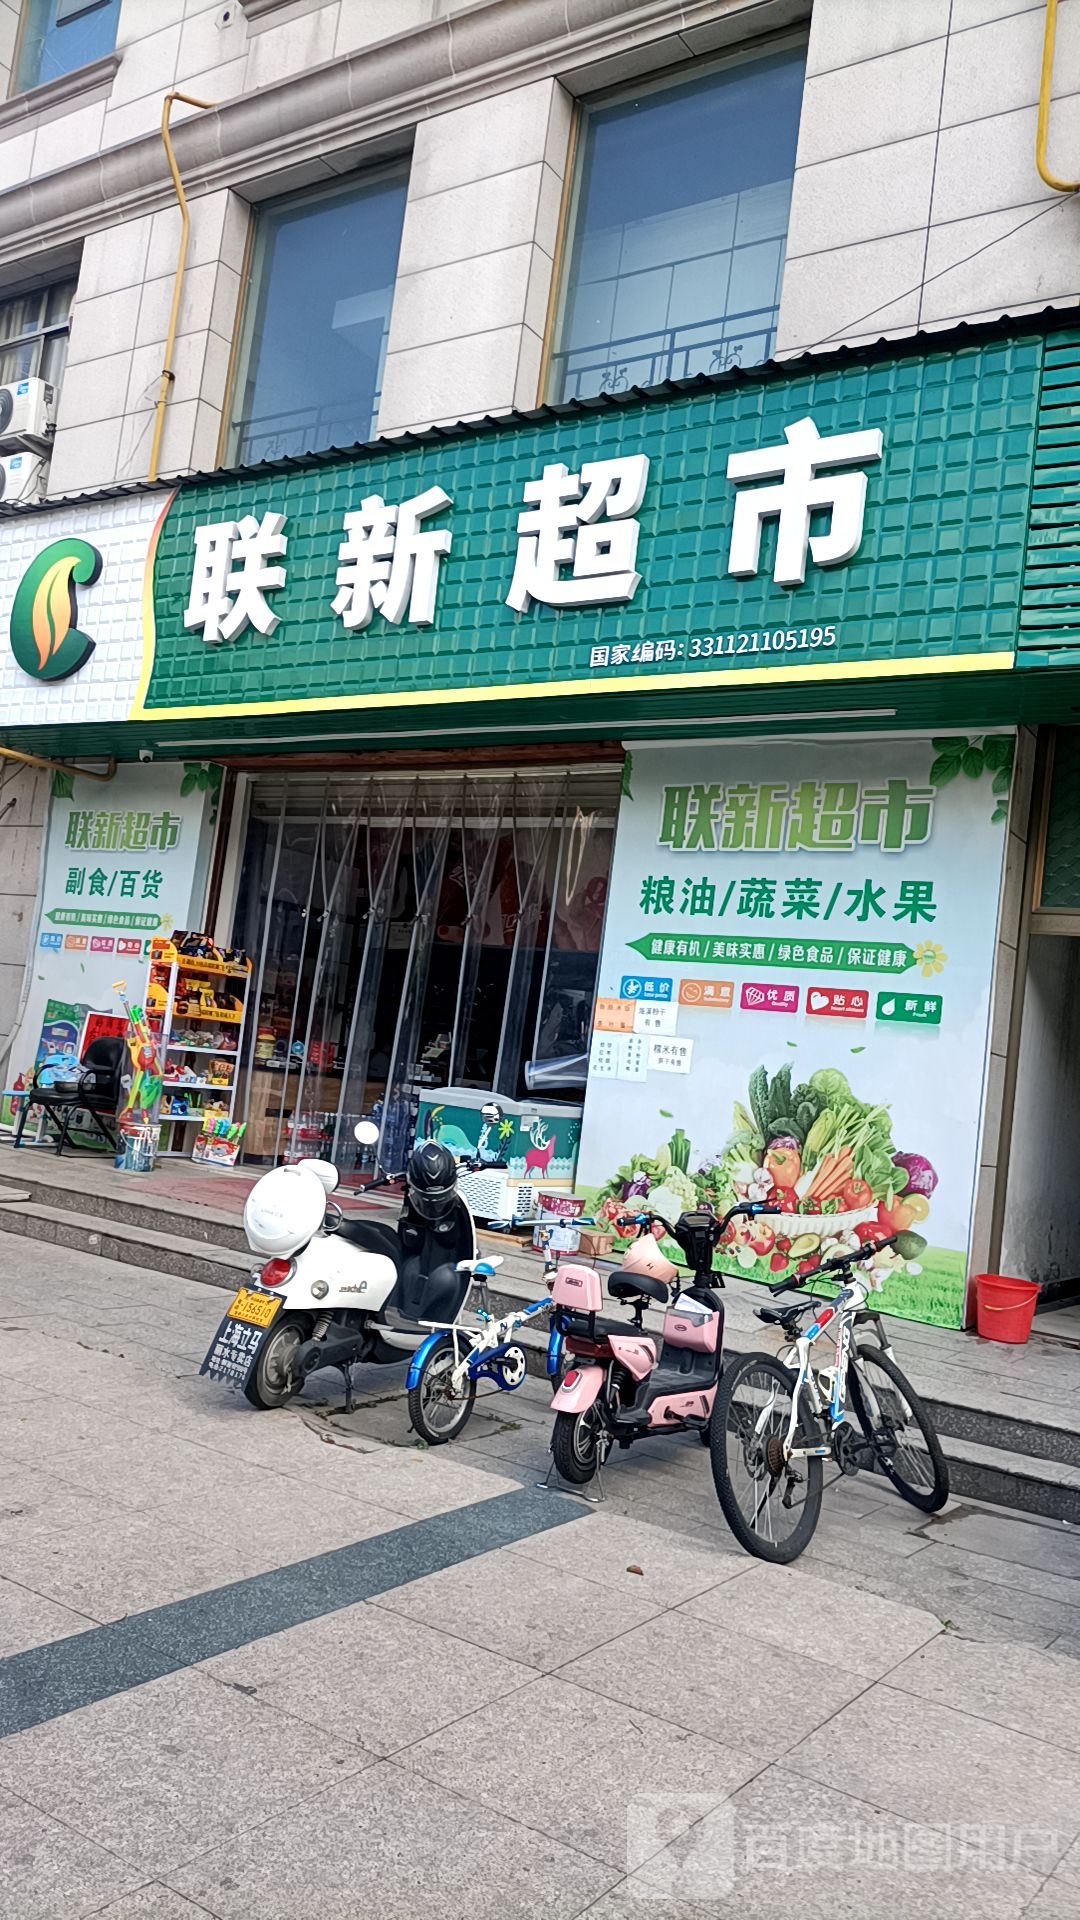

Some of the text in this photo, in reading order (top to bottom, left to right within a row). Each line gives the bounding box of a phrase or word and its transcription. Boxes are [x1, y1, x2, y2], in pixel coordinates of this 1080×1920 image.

[181, 416, 884, 643] 联新超市
[64, 810, 182, 853] 联新超市
[656, 779, 937, 853] 联新超市
[65, 867, 164, 899] 副食/百货
[640, 876, 937, 923] 粮油/蔬菜/水果
[644, 981, 670, 993] 低价
[703, 985, 731, 997] 满意
[766, 989, 796, 1003] 优质
[832, 994, 864, 1008] 贴心
[904, 999, 938, 1013] 新鲜
[218, 1320, 263, 1355] 上海立马
